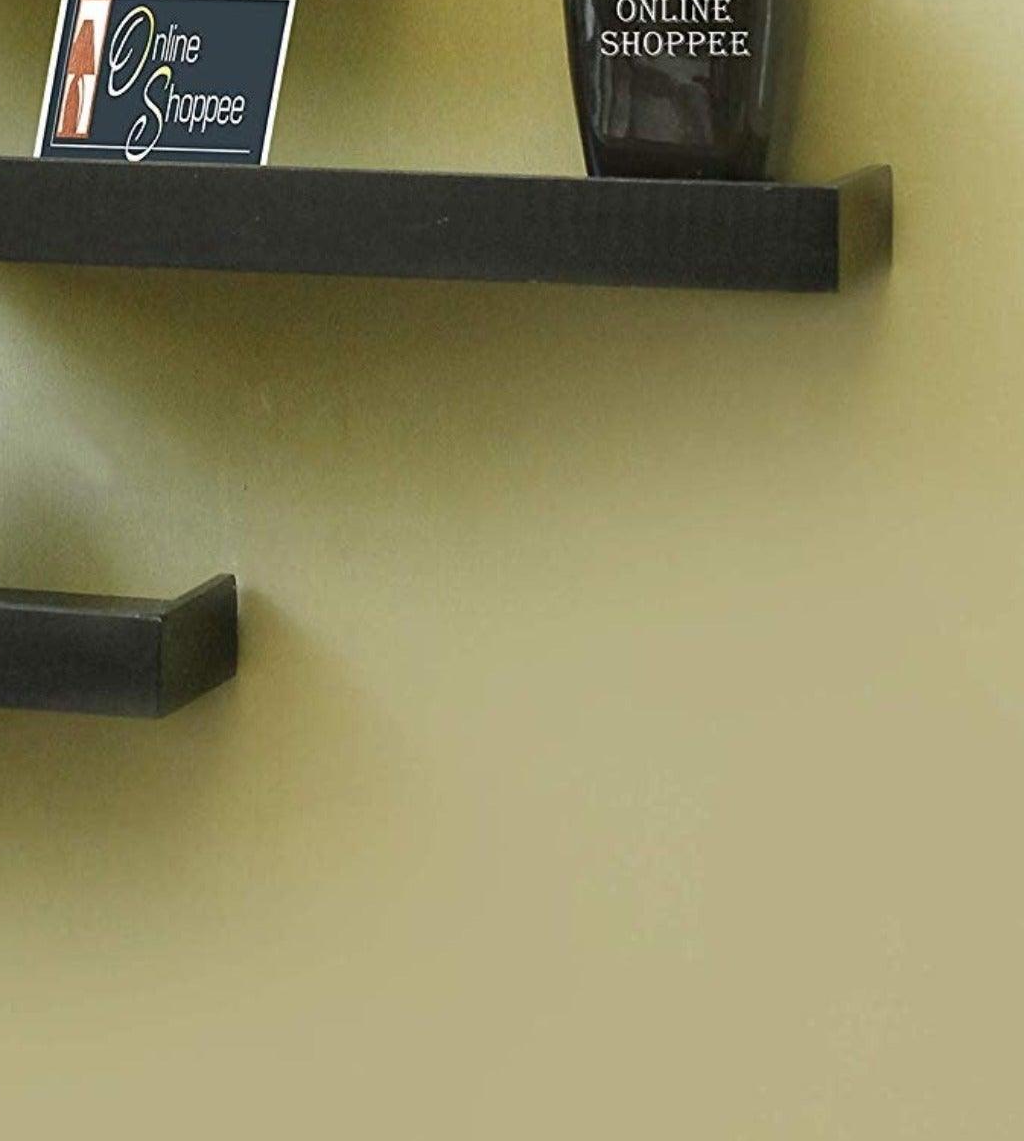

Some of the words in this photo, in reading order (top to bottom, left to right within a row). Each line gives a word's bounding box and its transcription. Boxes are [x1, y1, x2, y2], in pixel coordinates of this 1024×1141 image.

[107, 5, 202, 97] Online
[599, 30, 752, 57] SHOPPEE
[125, 65, 245, 162] Shoppee
